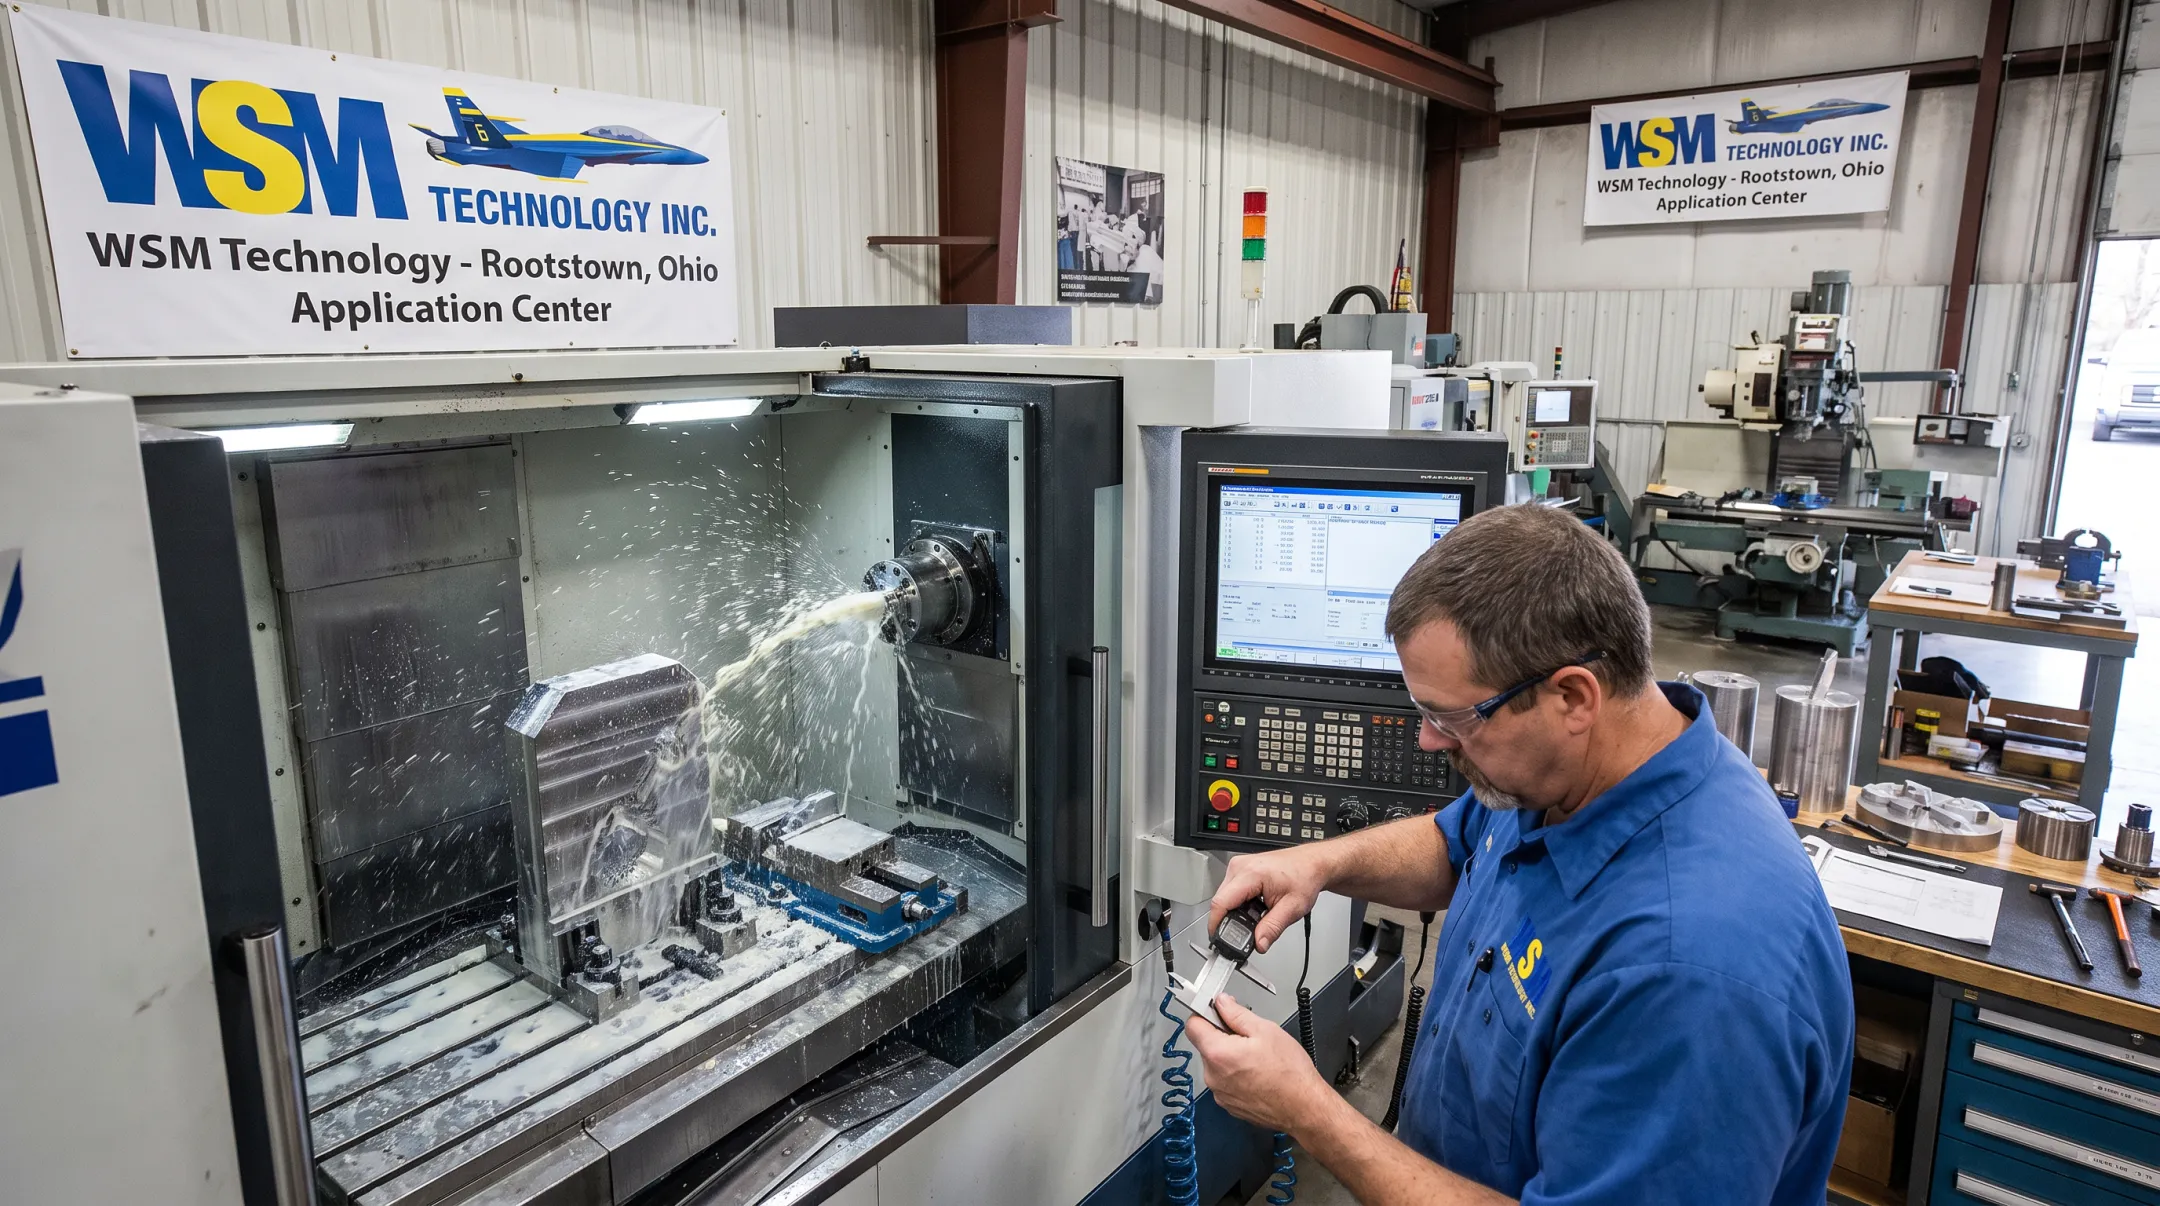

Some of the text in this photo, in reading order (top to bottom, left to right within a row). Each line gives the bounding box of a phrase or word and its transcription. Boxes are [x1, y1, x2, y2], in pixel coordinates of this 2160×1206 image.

[57, 59, 408, 220] WSM
[1600, 113, 1717, 170] WSM
[1726, 133, 1888, 161] TECHNOLOGY INC.
[1598, 178, 1634, 193] WSM
[1637, 174, 1727, 191] Technology
[1741, 168, 1837, 184] Rootstown,
[1842, 161, 1885, 178] Ohio
[428, 186, 717, 237] TECHNOLOGY INC.
[1656, 190, 1808, 214] Application Center
[86, 232, 212, 270] WSM
[219, 236, 452, 285] Technology
[482, 249, 651, 285] Rootstown,
[658, 255, 718, 282] Ohio
[292, 292, 612, 332] Application Center
